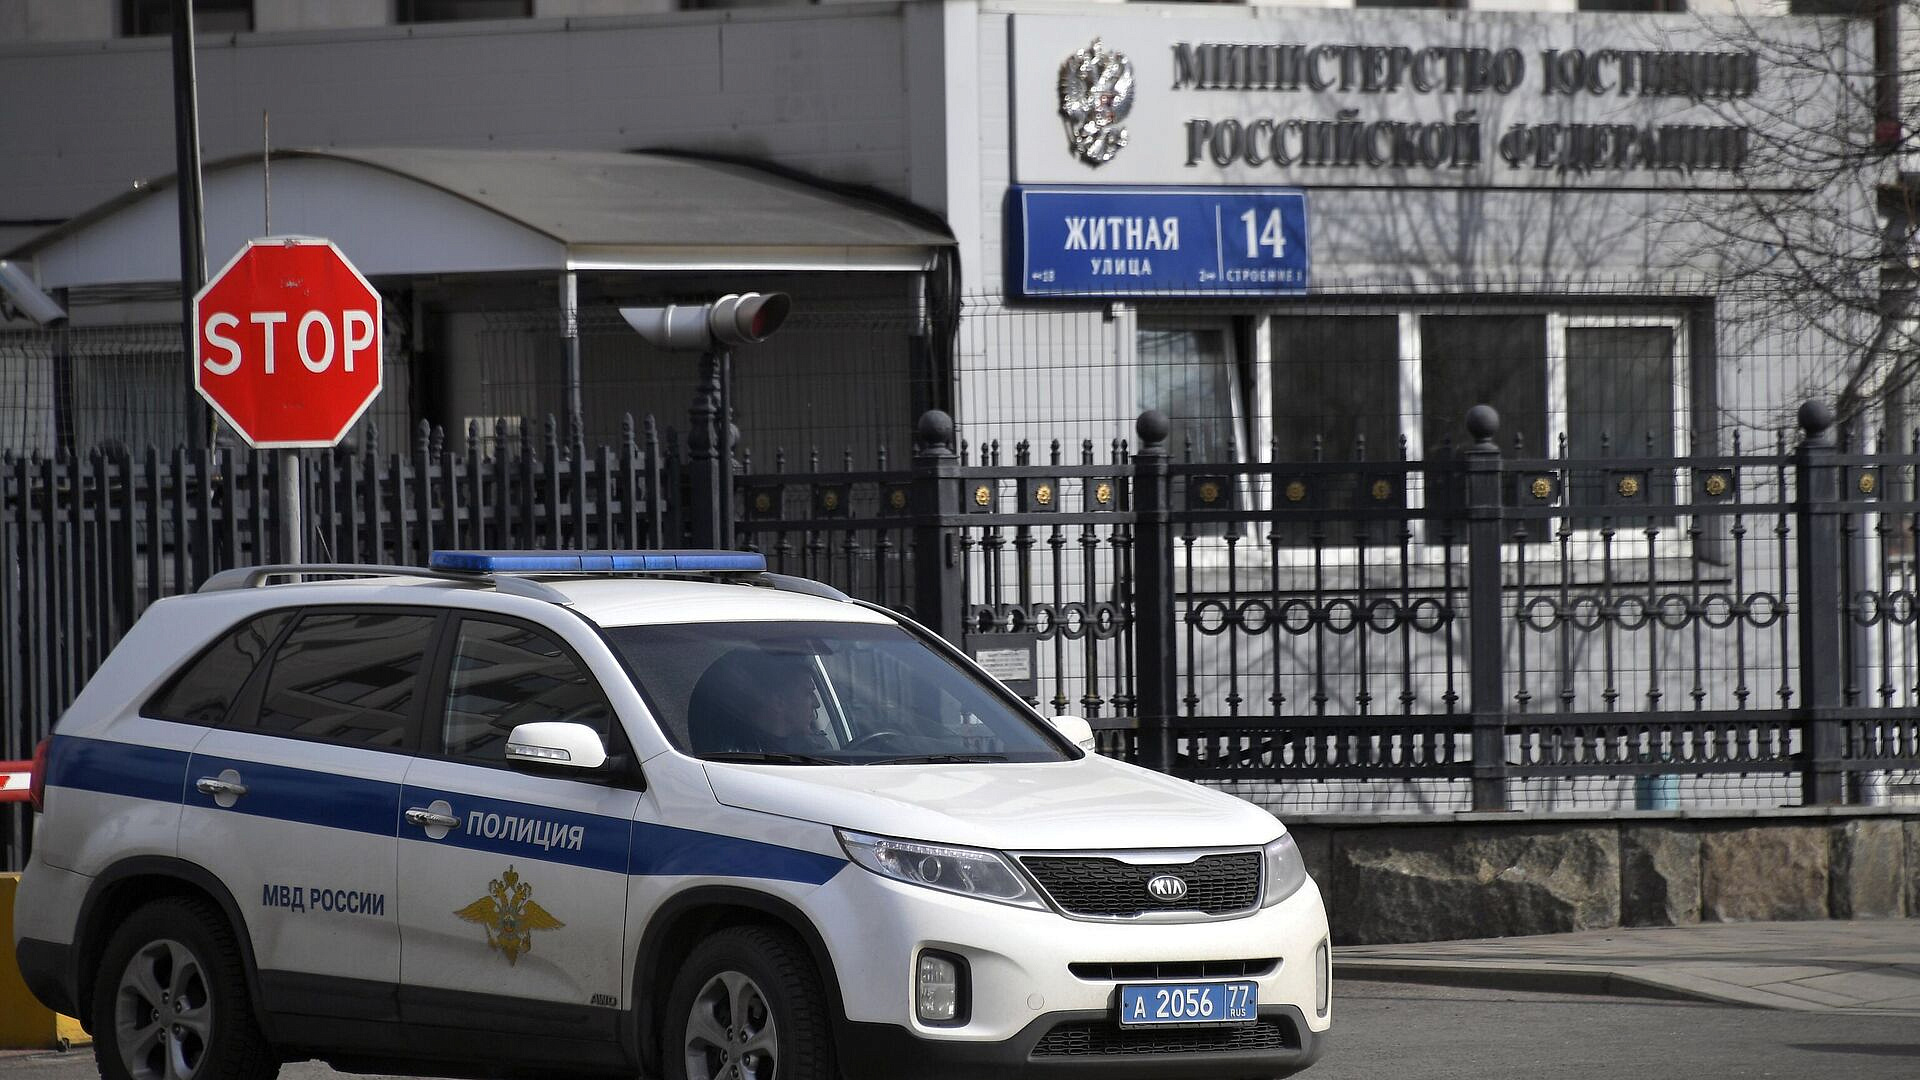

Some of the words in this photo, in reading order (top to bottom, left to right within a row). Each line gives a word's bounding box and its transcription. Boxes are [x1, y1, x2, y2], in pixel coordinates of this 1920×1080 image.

[1171, 42, 1525, 94] МИНИСТЕРСТВО
[1184, 110, 1481, 169] РОССИЙСКОЙ
[1063, 216, 1180, 251] ЖИТНАЯ
[1240, 207, 1287, 259] 14
[1090, 257, 1152, 276] УЛИЦА
[1226, 269, 1293, 282] СТРОЕНИЕ
[203, 309, 375, 376] STOP
[465, 810, 585, 852] ПОЛИЦИЯ
[262, 884, 305, 913] МВД
[309, 888, 385, 916] РОССИИ
[1152, 879, 1183, 895] KIA
[1156, 988, 1214, 1018] 2056
[1228, 985, 1249, 1008] 77
[1230, 1008, 1246, 1017] RUS
